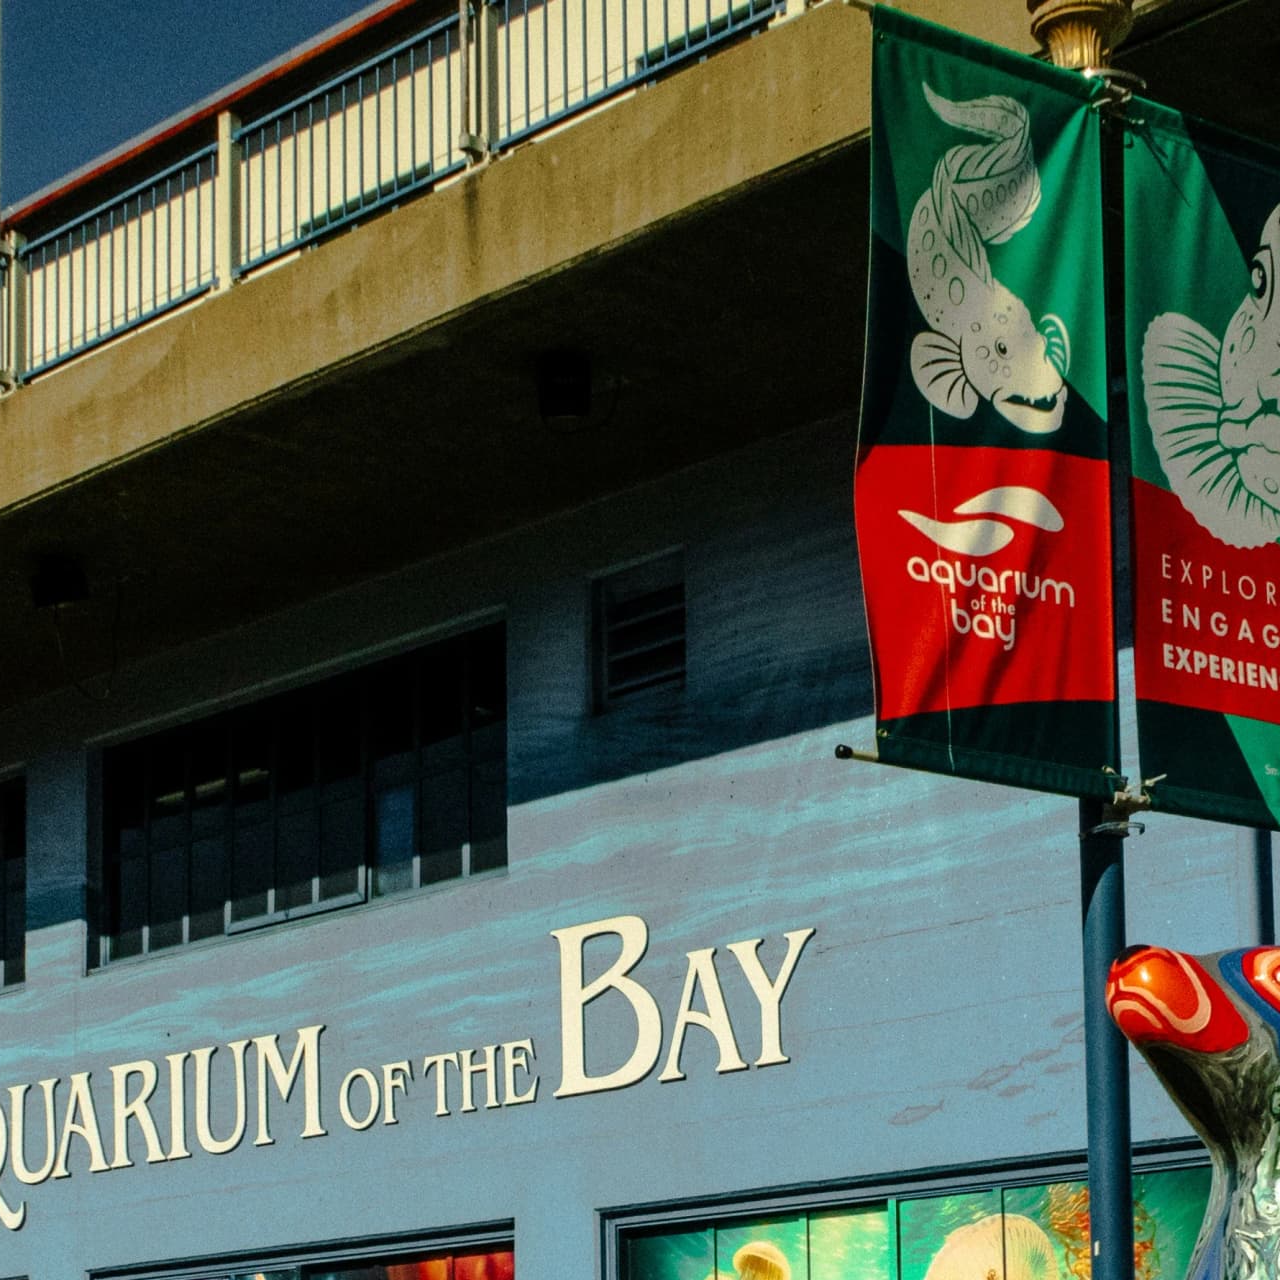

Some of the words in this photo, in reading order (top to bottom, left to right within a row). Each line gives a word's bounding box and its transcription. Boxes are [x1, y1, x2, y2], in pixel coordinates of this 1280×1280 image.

[907, 556, 1075, 608] aquarium
[971, 594, 986, 612] of
[991, 596, 1016, 616] the
[951, 598, 1016, 651] bay
[338, 1060, 414, 1131] OF
[424, 1037, 539, 1116] THE
[550, 915, 816, 1099] BAY
